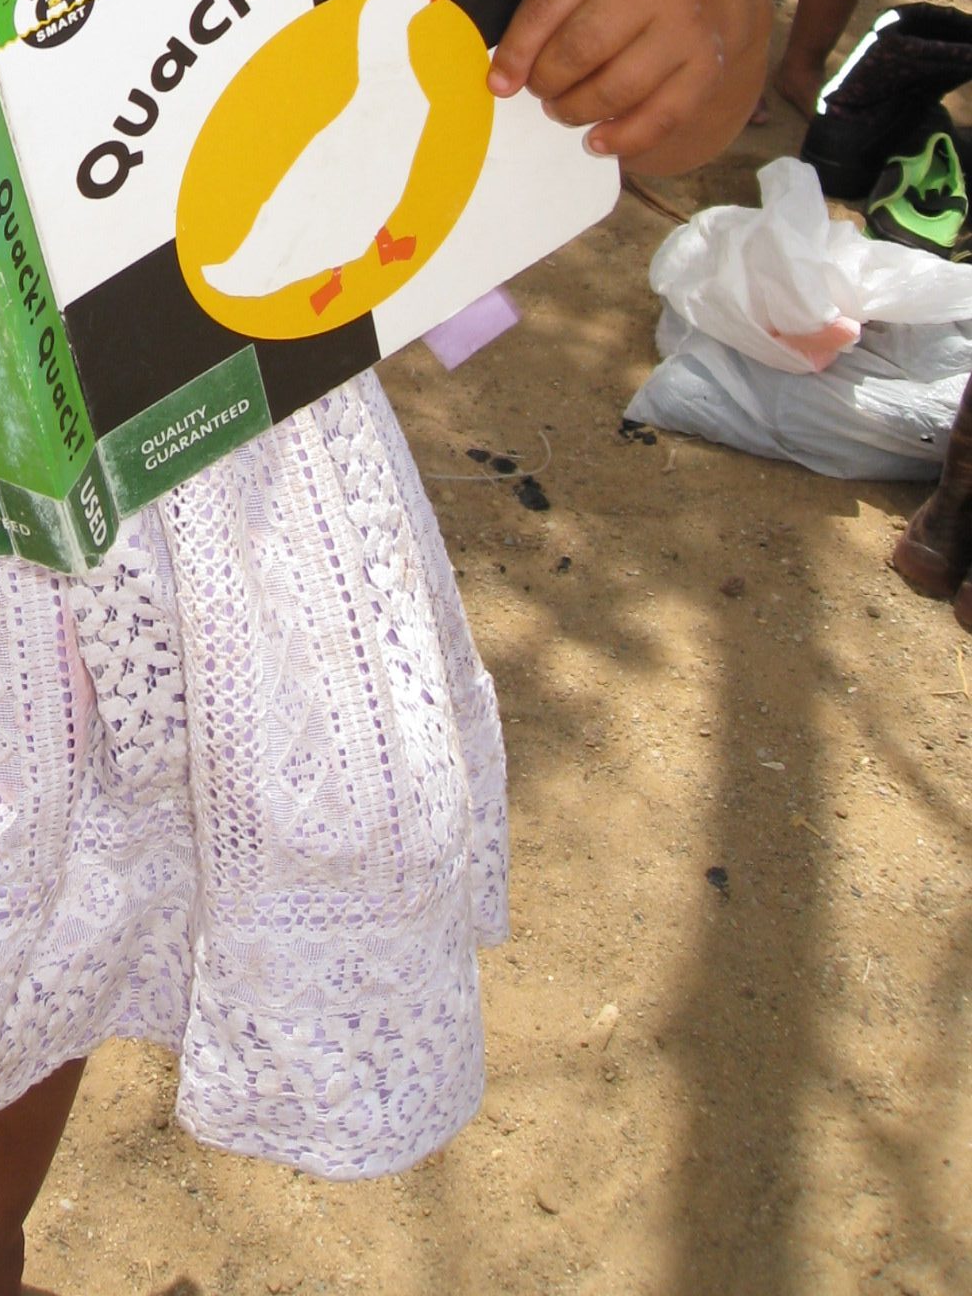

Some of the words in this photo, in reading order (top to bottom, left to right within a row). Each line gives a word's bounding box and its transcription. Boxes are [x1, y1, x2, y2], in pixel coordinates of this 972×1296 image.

[35, 4, 87, 43] SMART
[39, 326, 85, 461] Quack!
[140, 405, 207, 456] QUALITY
[145, 398, 250, 471] GUARANTEED
[79, 476, 107, 546] USED
